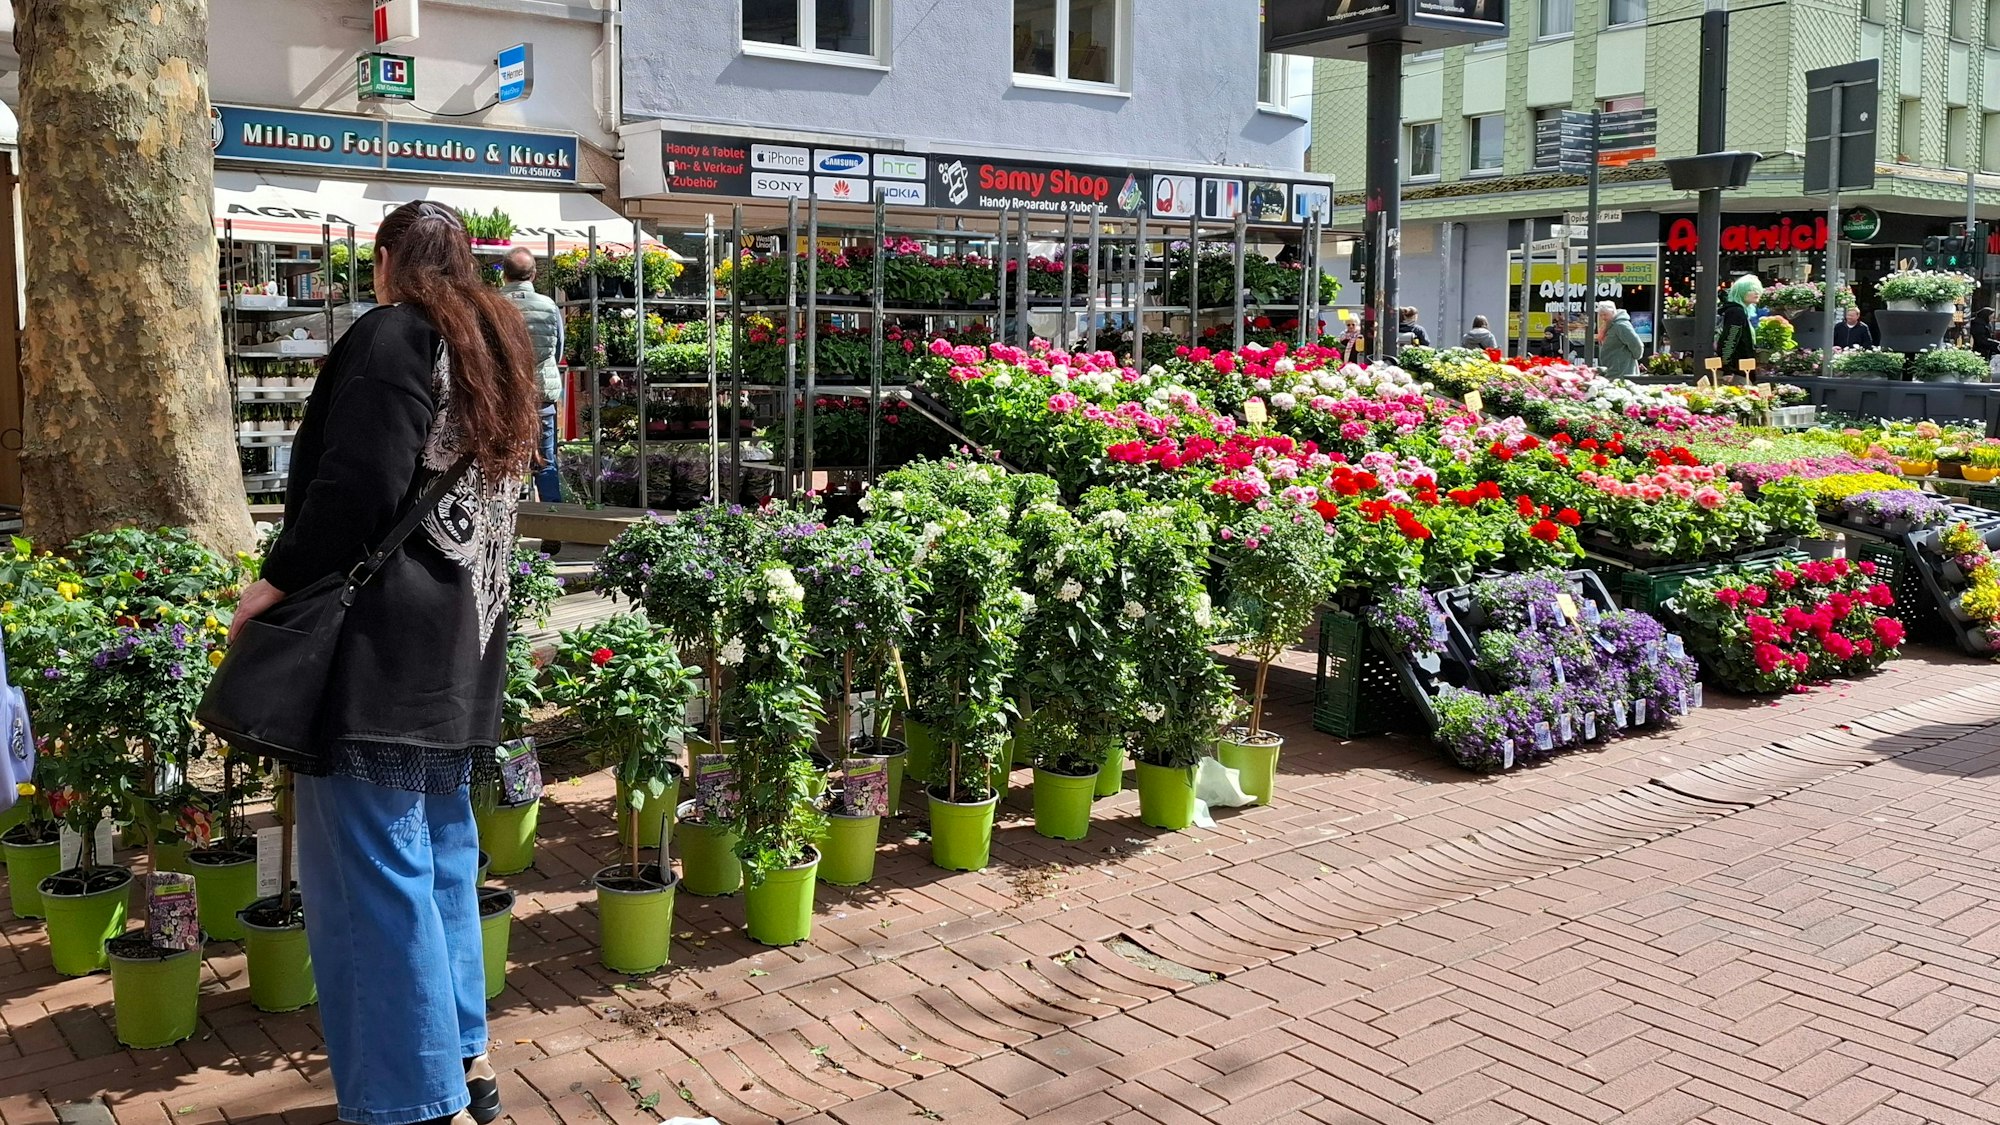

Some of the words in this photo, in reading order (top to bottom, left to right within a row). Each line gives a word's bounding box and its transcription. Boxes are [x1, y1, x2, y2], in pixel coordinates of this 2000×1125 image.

[244, 122, 332, 150] Milano
[343, 131, 476, 160] Fotostudio
[487, 144, 500, 161] &
[510, 145, 568, 167] Kiosk
[666, 142, 700, 157] Handy
[702, 146, 710, 157] &
[712, 146, 745, 159] Tablet
[768, 151, 804, 166] iPhone
[824, 158, 859, 167] SAMSUNG
[510, 166, 528, 176] 0176
[528, 167, 561, 178] 45611765
[674, 160, 691, 171] An-
[693, 162, 701, 171] &
[703, 162, 744, 174] Verkauf
[673, 175, 717, 188] Zubehör
[757, 179, 804, 192] SONY
[979, 164, 1045, 198] Samy
[1050, 169, 1109, 200] Shop
[979, 195, 1010, 209] Handy
[1061, 201, 1068, 211] &
[227, 203, 358, 226] AGFA
[1843, 223, 1875, 231] Heineken
